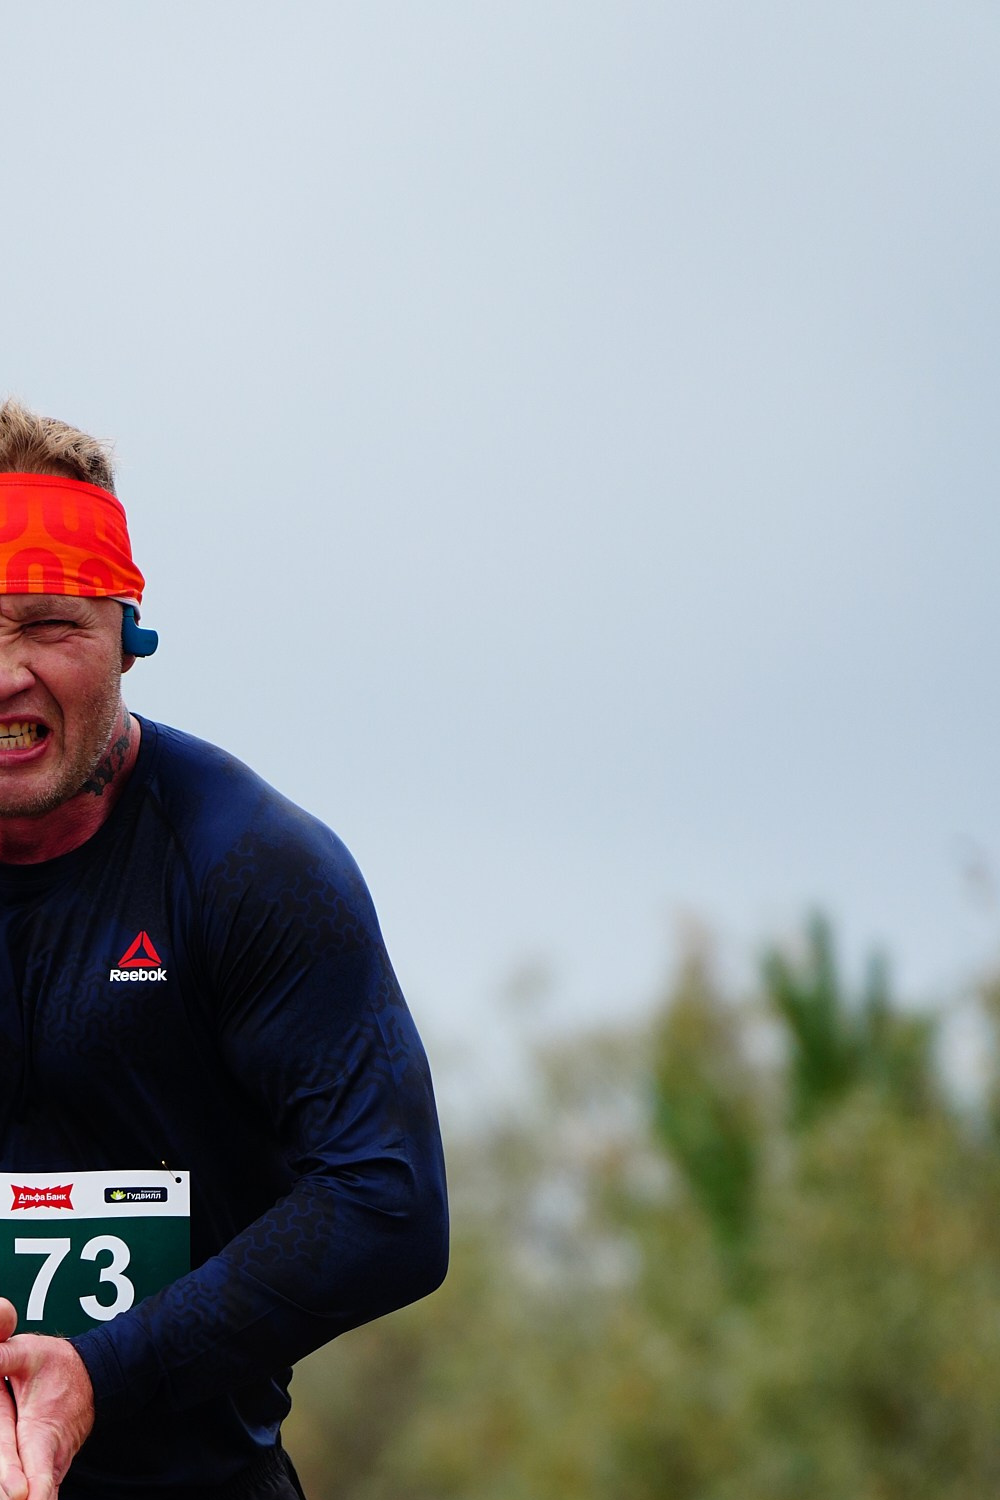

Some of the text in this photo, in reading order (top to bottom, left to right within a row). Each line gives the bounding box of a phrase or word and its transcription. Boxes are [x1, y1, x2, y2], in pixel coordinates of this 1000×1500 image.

[109, 968, 168, 982] Reebok
[18, 1192, 67, 1203] Альфа Банк
[126, 1192, 162, 1201] Гудвилл
